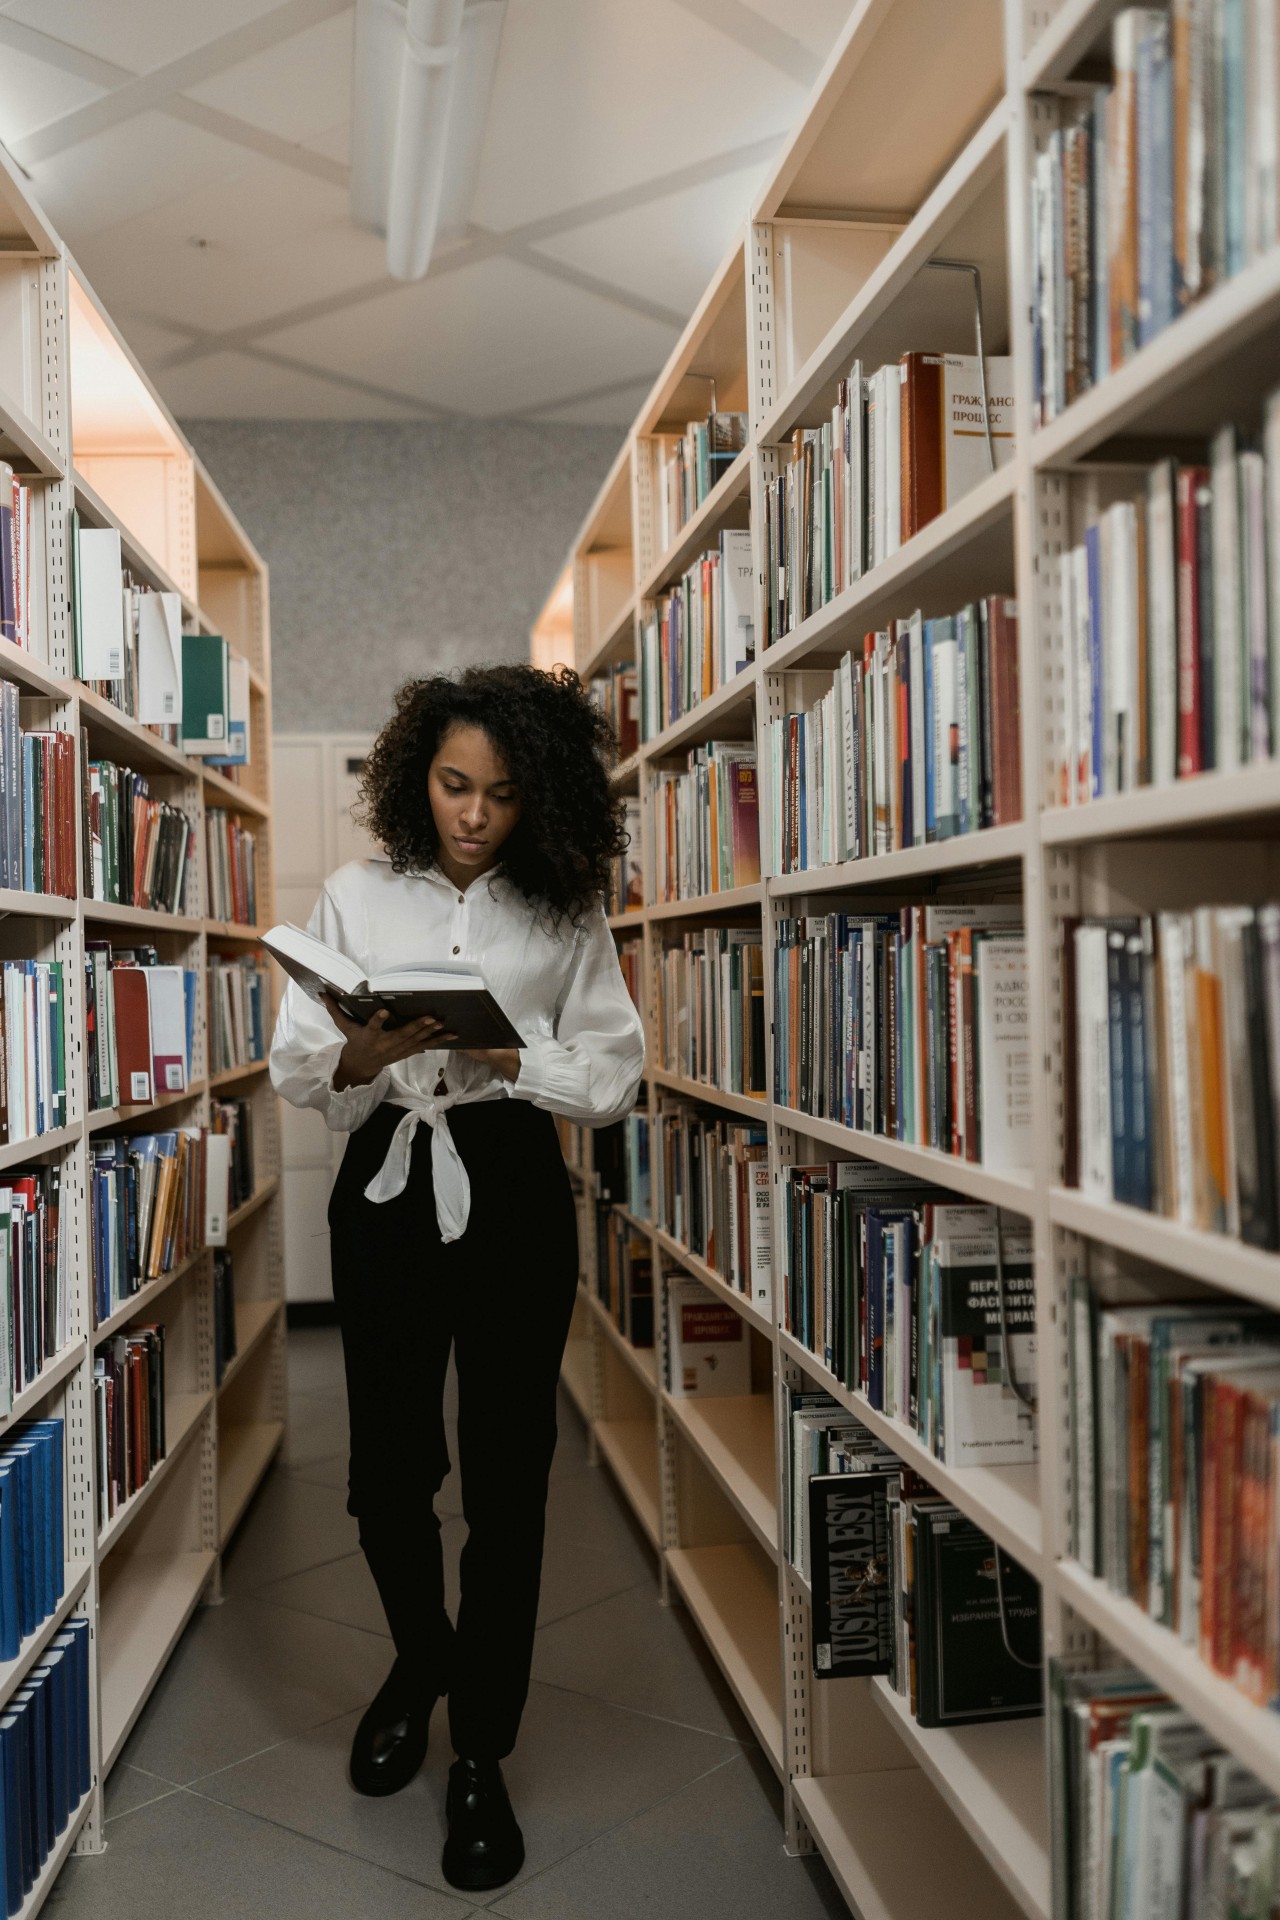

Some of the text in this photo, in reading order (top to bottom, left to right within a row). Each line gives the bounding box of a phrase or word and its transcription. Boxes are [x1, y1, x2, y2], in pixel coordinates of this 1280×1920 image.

[952, 394, 1015, 407] ГРАЖАНС
[953, 411, 1002, 424] ПРОЦСС
[844, 708, 853, 828] НОТАРИАТ
[99, 980, 107, 1086] КРИМИНАЛИСТИКА
[864, 962, 872, 1117] АДВОКАТУРА
[969, 1278, 1034, 1292] ПЕРЕОВО
[825, 1492, 875, 1544] EST
[952, 1607, 1037, 1623] ИЗБРАННЫ ТРУДЫ
